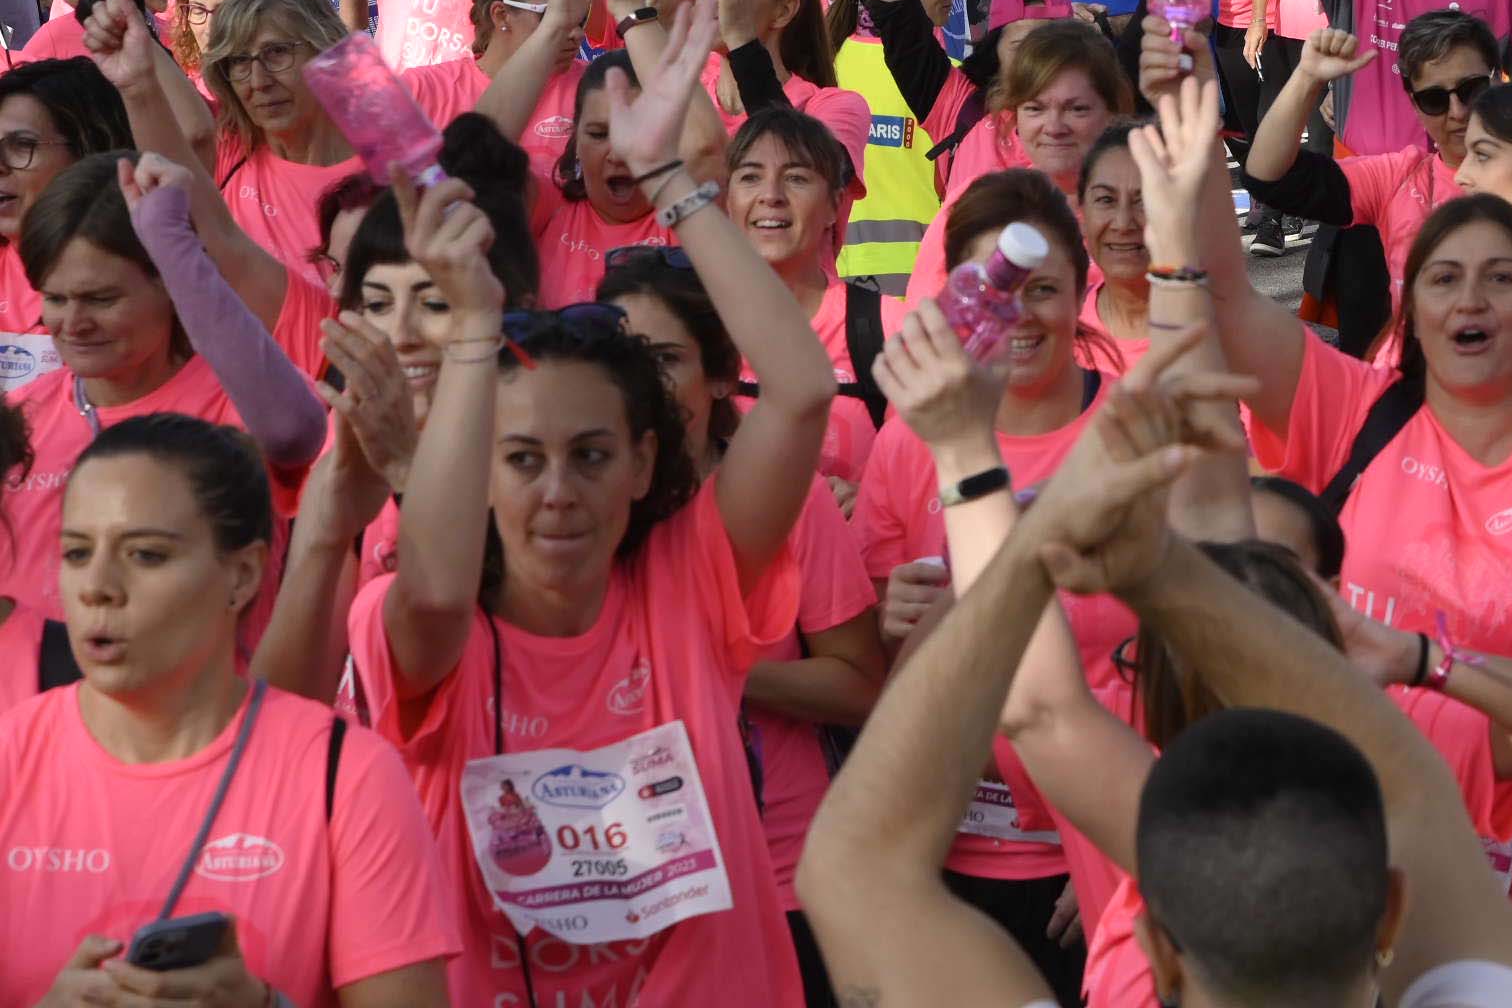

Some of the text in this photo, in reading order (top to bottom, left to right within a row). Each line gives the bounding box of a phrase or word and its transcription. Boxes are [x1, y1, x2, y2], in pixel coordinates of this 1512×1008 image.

[407, 17, 475, 58] DORSA
[403, 41, 443, 68] SUM
[1401, 455, 1449, 490] OYSH
[1347, 582, 1396, 627] TU
[538, 781, 619, 800] ASTURIANA
[556, 821, 627, 851] 016
[7, 846, 111, 873] OYSHO
[571, 858, 629, 878] 27005
[516, 888, 580, 907] CARRERA
[582, 887, 602, 900] DE
[603, 885, 621, 897] LA
[640, 884, 710, 921] Santander
